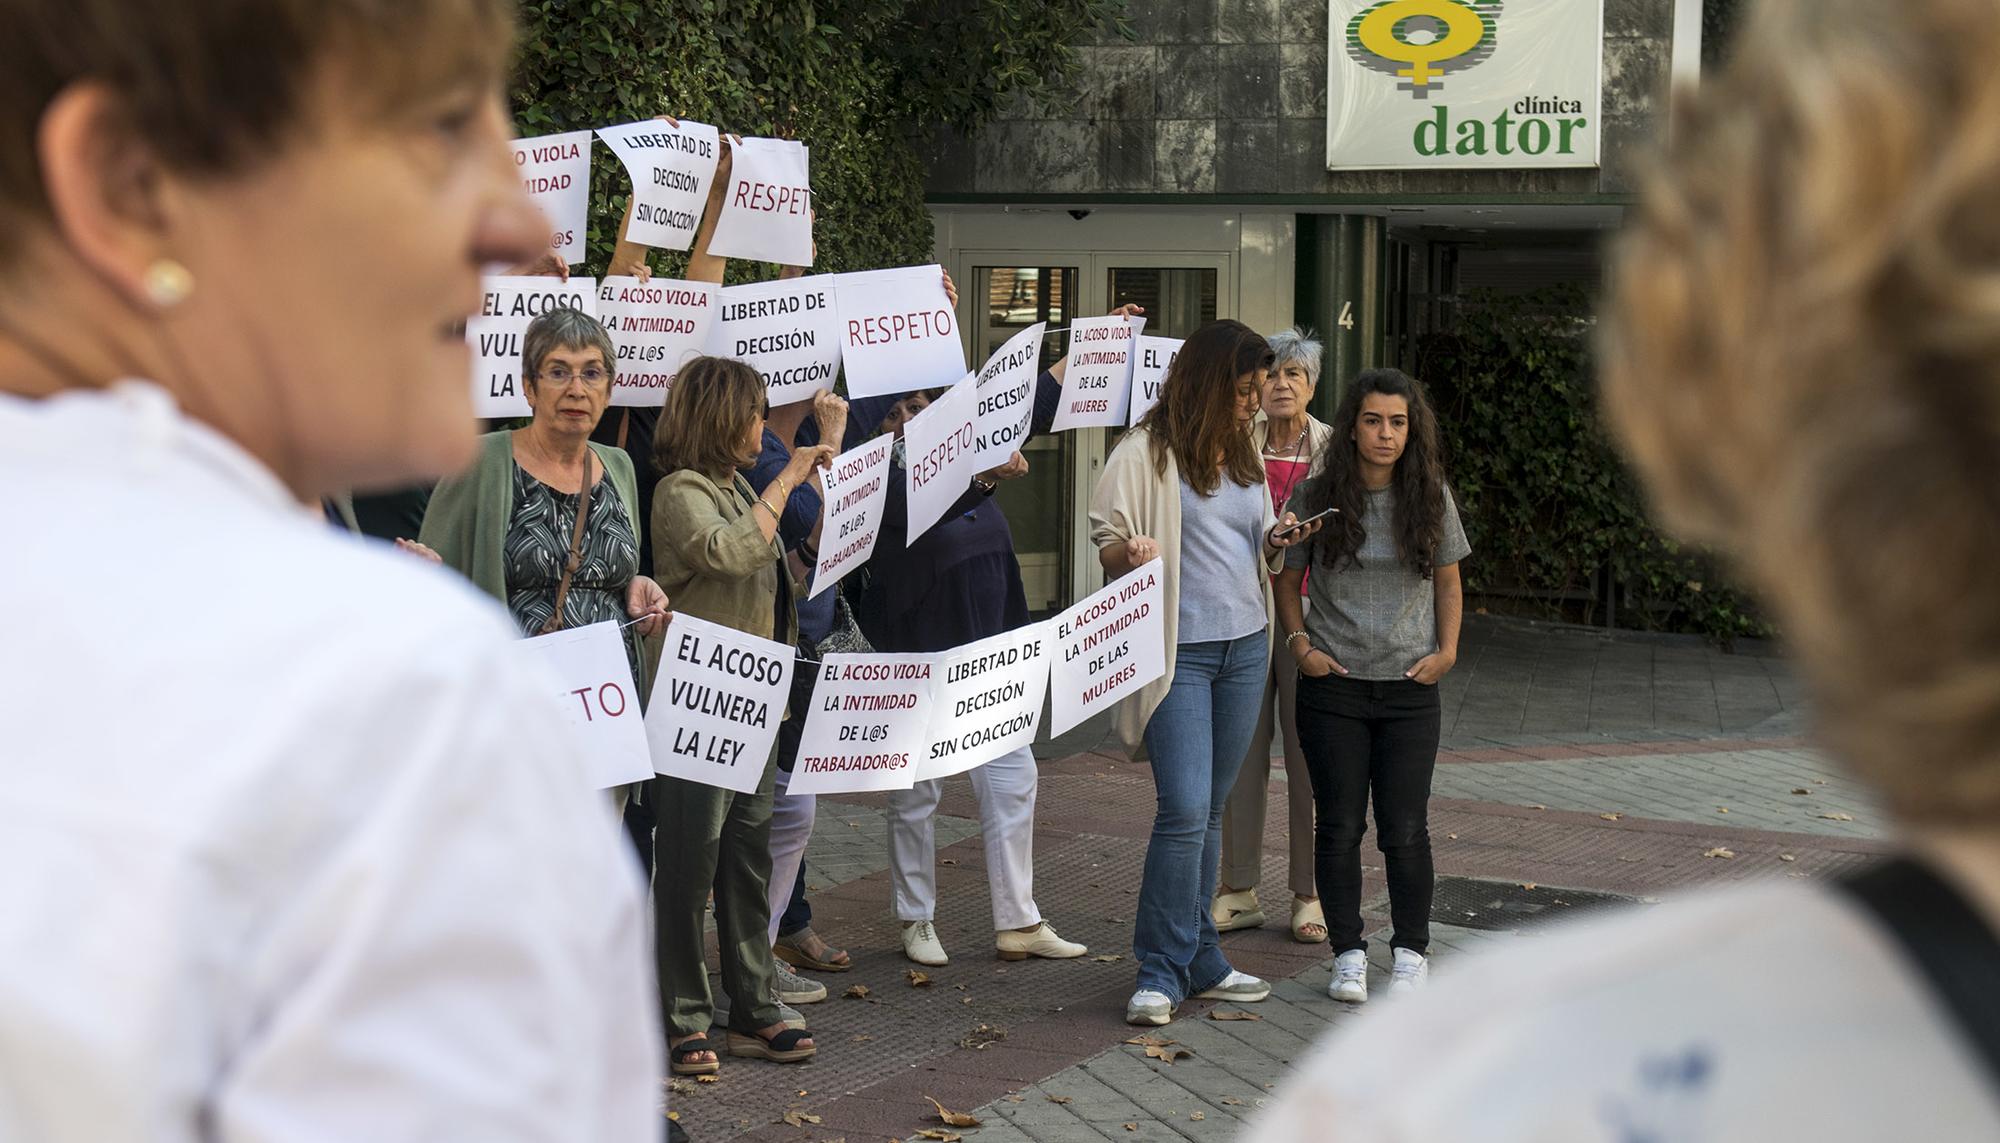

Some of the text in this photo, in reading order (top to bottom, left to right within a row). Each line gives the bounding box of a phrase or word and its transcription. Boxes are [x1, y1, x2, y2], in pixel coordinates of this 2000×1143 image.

[1514, 96, 1583, 115] clínica
[1413, 105, 1587, 156] dator
[533, 144, 580, 163] VIOLA
[623, 133, 712, 159] LIBERTAD DE
[653, 167, 699, 194] DECISIÓN
[734, 180, 809, 216] RESPET
[637, 203, 698, 231] SIN COACCIÓN
[482, 293, 503, 316] EL
[600, 286, 707, 307] EL ACOSO VIOLA
[722, 292, 826, 322] LIBERTAD DE
[621, 316, 695, 334] INTIMIDAD
[848, 310, 951, 347] RESPETO
[1338, 301, 1354, 329] 4
[736, 328, 815, 356] DECISIÓN
[1074, 326, 1132, 343] EL ACOSO VIOLA
[618, 345, 665, 362] DE L@S
[1073, 351, 1127, 367] LA INTIMIDAD
[1144, 349, 1161, 369] EL
[613, 372, 677, 390] AJADOR@
[761, 361, 831, 387] OACCIÓN
[976, 350, 1023, 388] LIBERTAD
[1079, 376, 1108, 390] DE LAS
[490, 373, 515, 397] LA
[978, 379, 1031, 417] DECISIÓN
[1070, 399, 1108, 414] MUJERES
[825, 446, 885, 489] EL ACOSO VIOLA
[913, 422, 973, 492] RESPETO
[831, 476, 880, 517] LA INTIMIDAD
[840, 511, 866, 540] DE L@S
[819, 530, 874, 577] TRABAJADOR@S
[1059, 574, 1156, 640] EL ACOSO VIOLA
[1065, 602, 1150, 663] LA INTIMIDAD
[677, 633, 783, 687] EL ACOSO
[824, 663, 931, 681] EL ACOSO VIOLA
[947, 640, 1042, 684] LIBERTAD DE
[1089, 641, 1129, 676] DE LAS
[1081, 662, 1136, 706] MUJERES
[671, 678, 768, 729] VULNERA
[823, 693, 917, 712] LA INTIMIDAD
[955, 679, 1025, 718] DECISIÓN
[672, 727, 746, 767] LA LEY
[839, 724, 889, 742] DE L@S
[929, 711, 1034, 760] SIN COACCIÓN
[804, 753, 909, 773] TRABAJADOR@S
